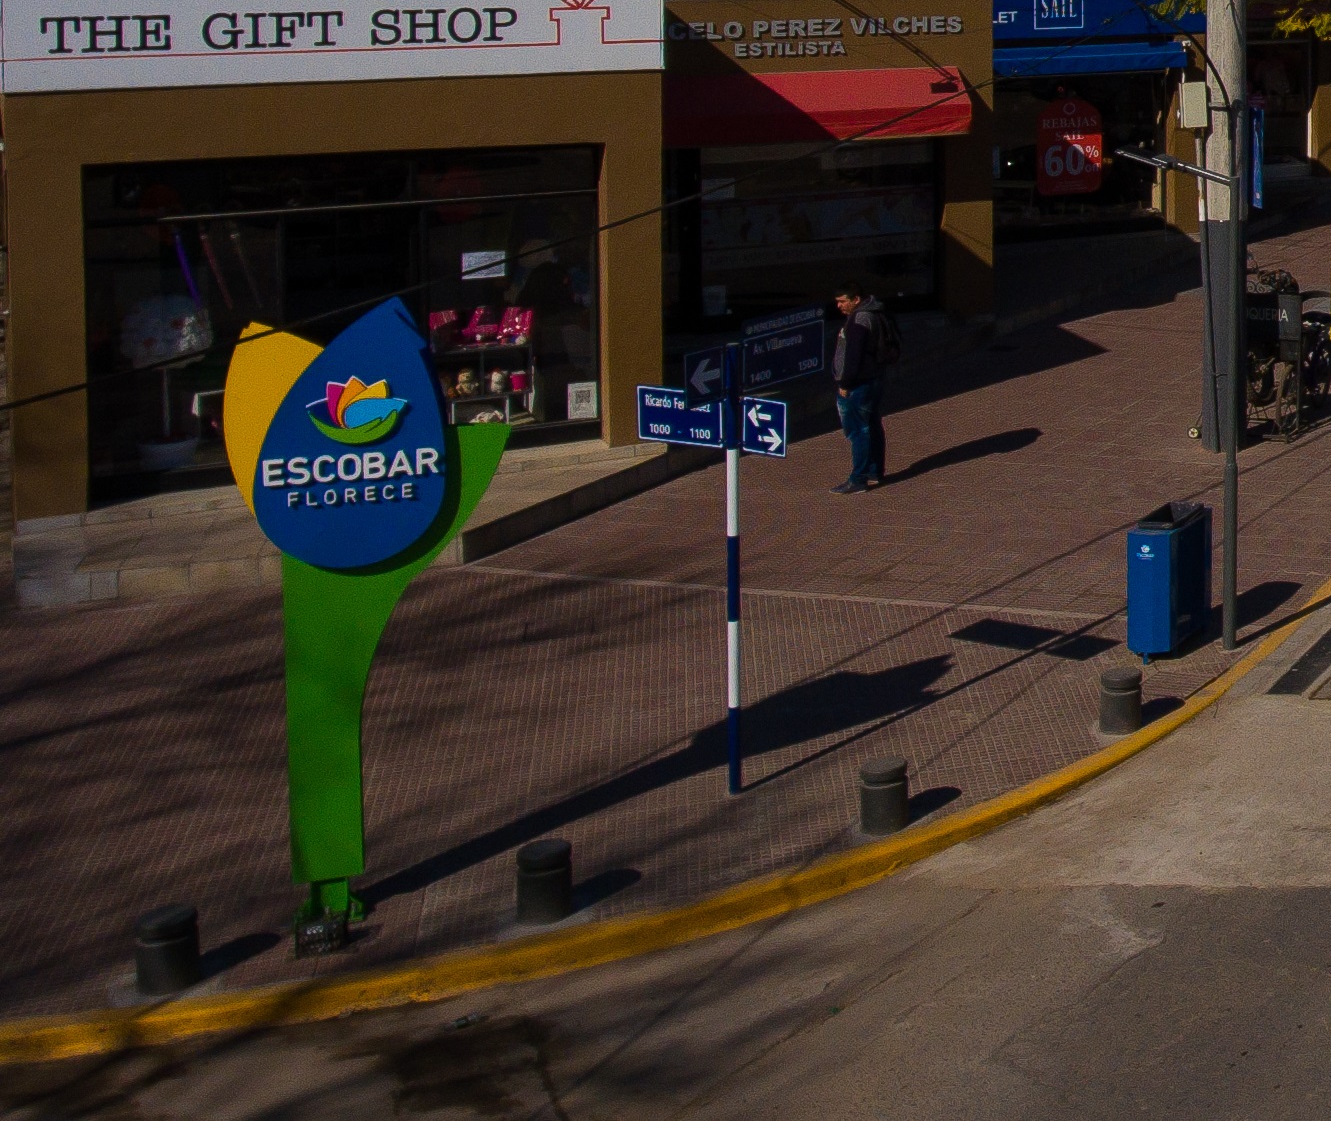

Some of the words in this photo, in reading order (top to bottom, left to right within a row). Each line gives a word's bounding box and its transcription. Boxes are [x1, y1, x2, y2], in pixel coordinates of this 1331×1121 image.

[41, 15, 172, 54] THE
[203, 10, 345, 50] GIFT
[372, 7, 519, 46] SHOP
[752, 18, 842, 38] PEREZ
[850, 15, 963, 35] VILCHES
[734, 40, 847, 57] ESTILISTA
[1042, 116, 1098, 129] REBAJAS
[751, 369, 772, 383] 1400
[799, 357, 818, 370] 1500
[645, 394, 672, 408] Ricardo
[649, 424, 670, 435] 1000
[690, 428, 711, 439] 1100
[261, 447, 439, 487] ESCOBAR
[287, 482, 413, 507] FLORECE
